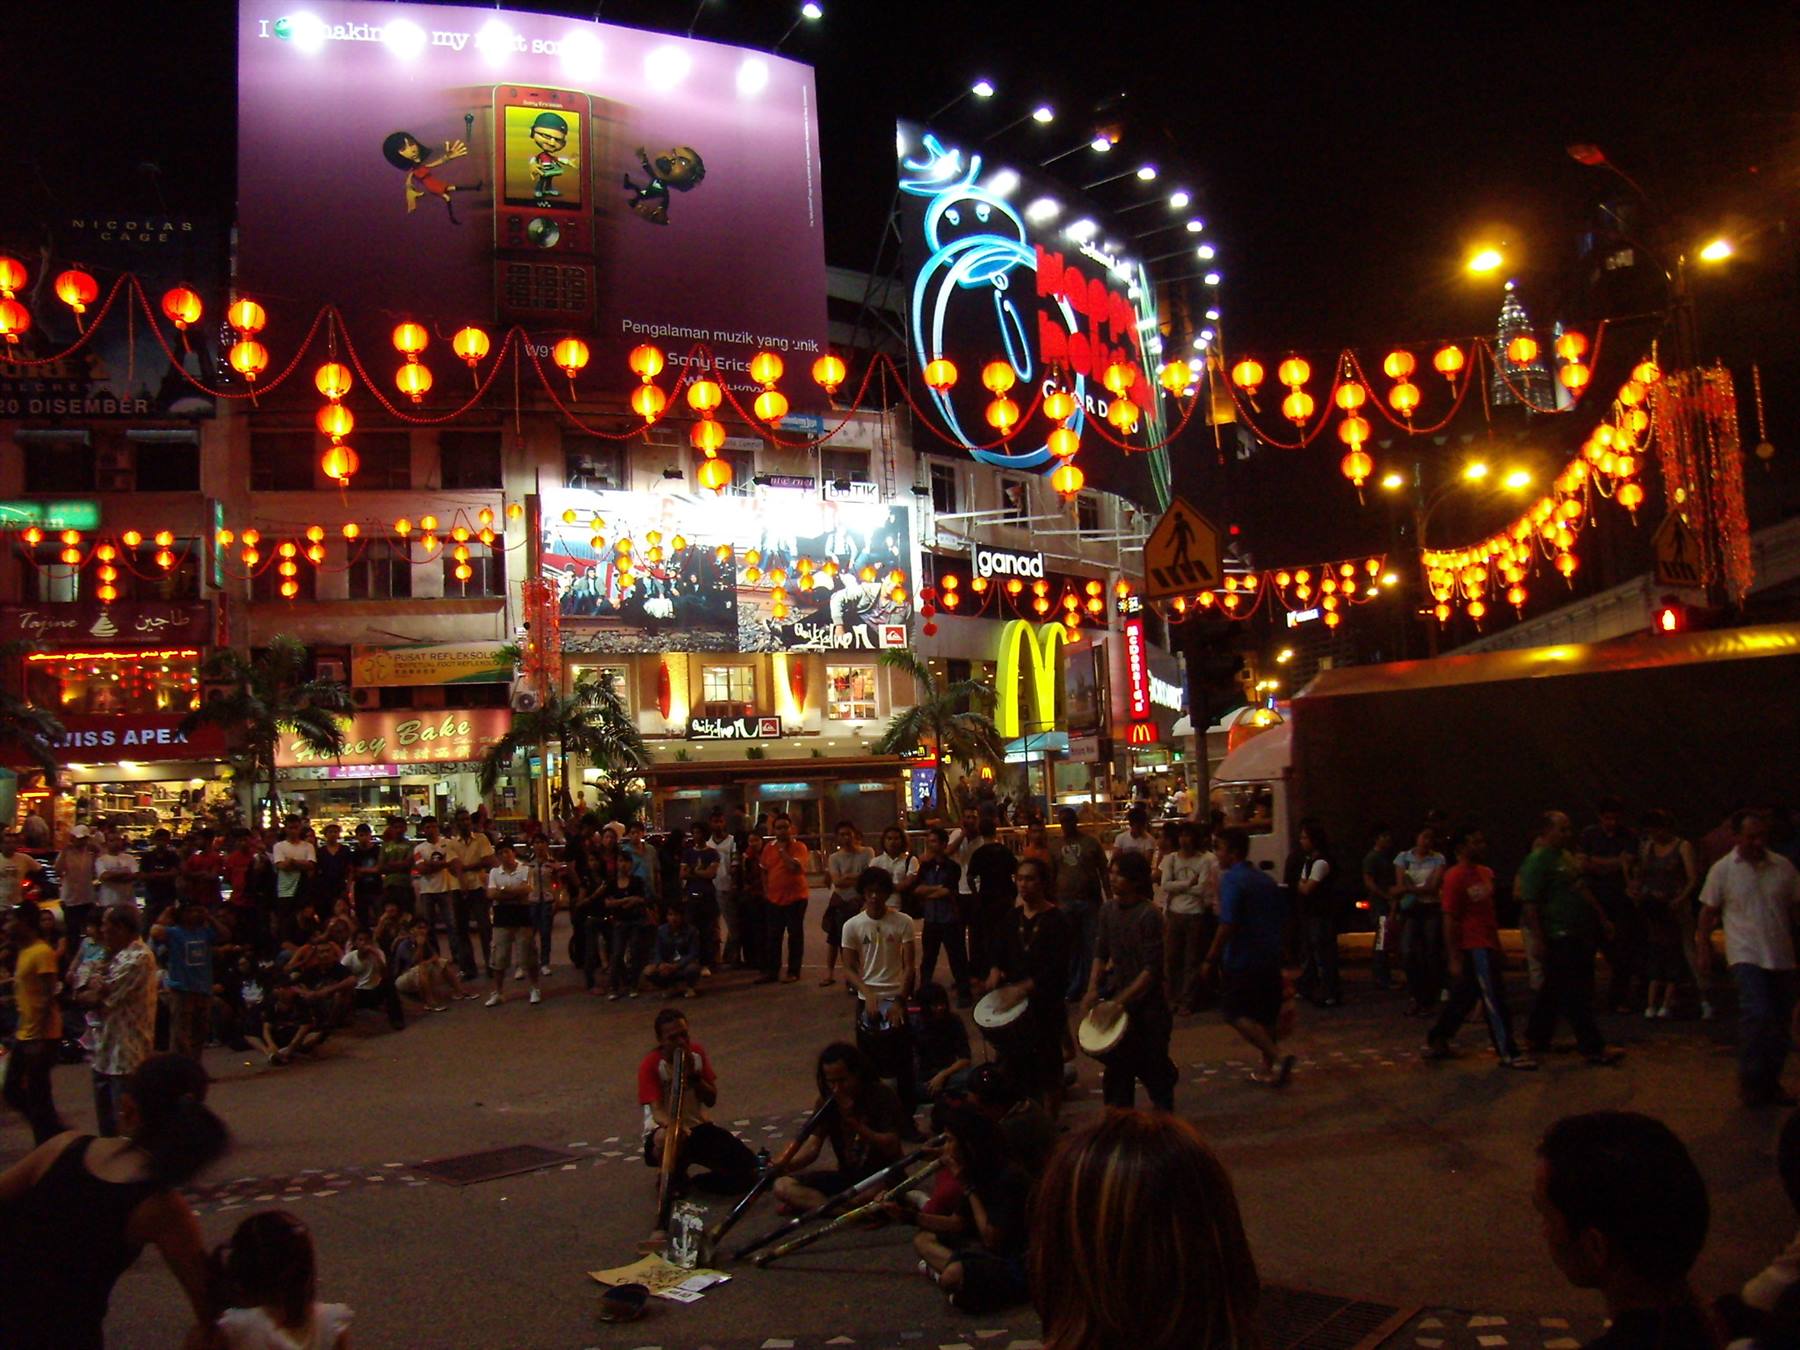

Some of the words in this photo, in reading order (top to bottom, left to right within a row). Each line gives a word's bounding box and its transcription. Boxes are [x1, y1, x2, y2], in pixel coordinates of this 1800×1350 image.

[258, 19, 270, 38] I
[432, 30, 470, 52] my
[72, 219, 192, 232] NICOLAS
[100, 232, 168, 242] CAGE
[622, 319, 710, 340] Pengalaman
[714, 331, 755, 345] muzik
[757, 334, 788, 351] yang
[667, 352, 711, 371] Sony
[29, 399, 149, 415] DISEMBER
[977, 550, 1044, 578] ganad
[395, 714, 473, 746] Bake
[918, 786, 930, 799] 24
